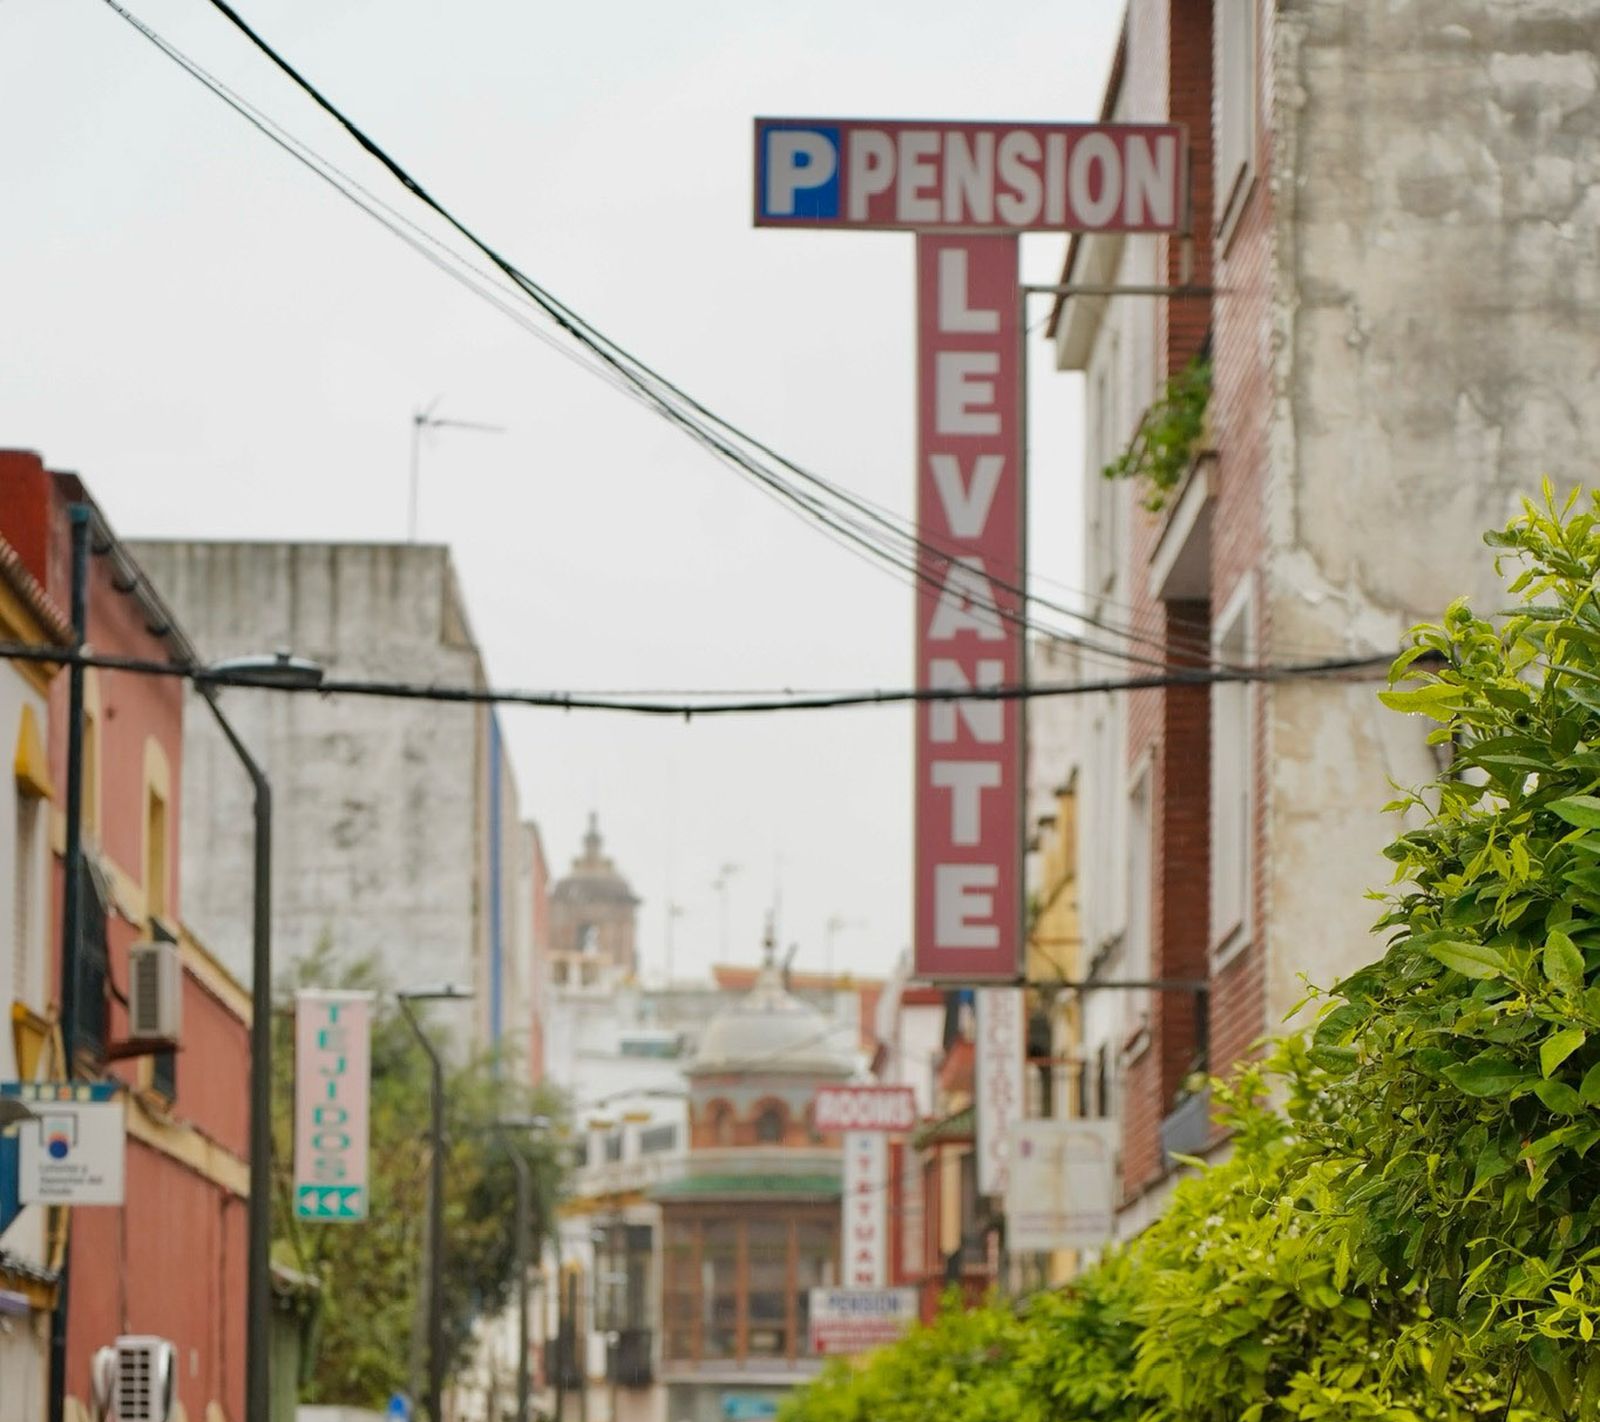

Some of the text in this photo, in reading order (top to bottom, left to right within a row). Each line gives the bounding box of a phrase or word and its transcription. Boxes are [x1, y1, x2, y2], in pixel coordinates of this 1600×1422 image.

[766, 129, 1177, 227] P PENSION
[929, 248, 1007, 948] LEVANTE
[311, 1001, 351, 1181] TEJIDOS
[816, 1091, 915, 1127] ROOMS
